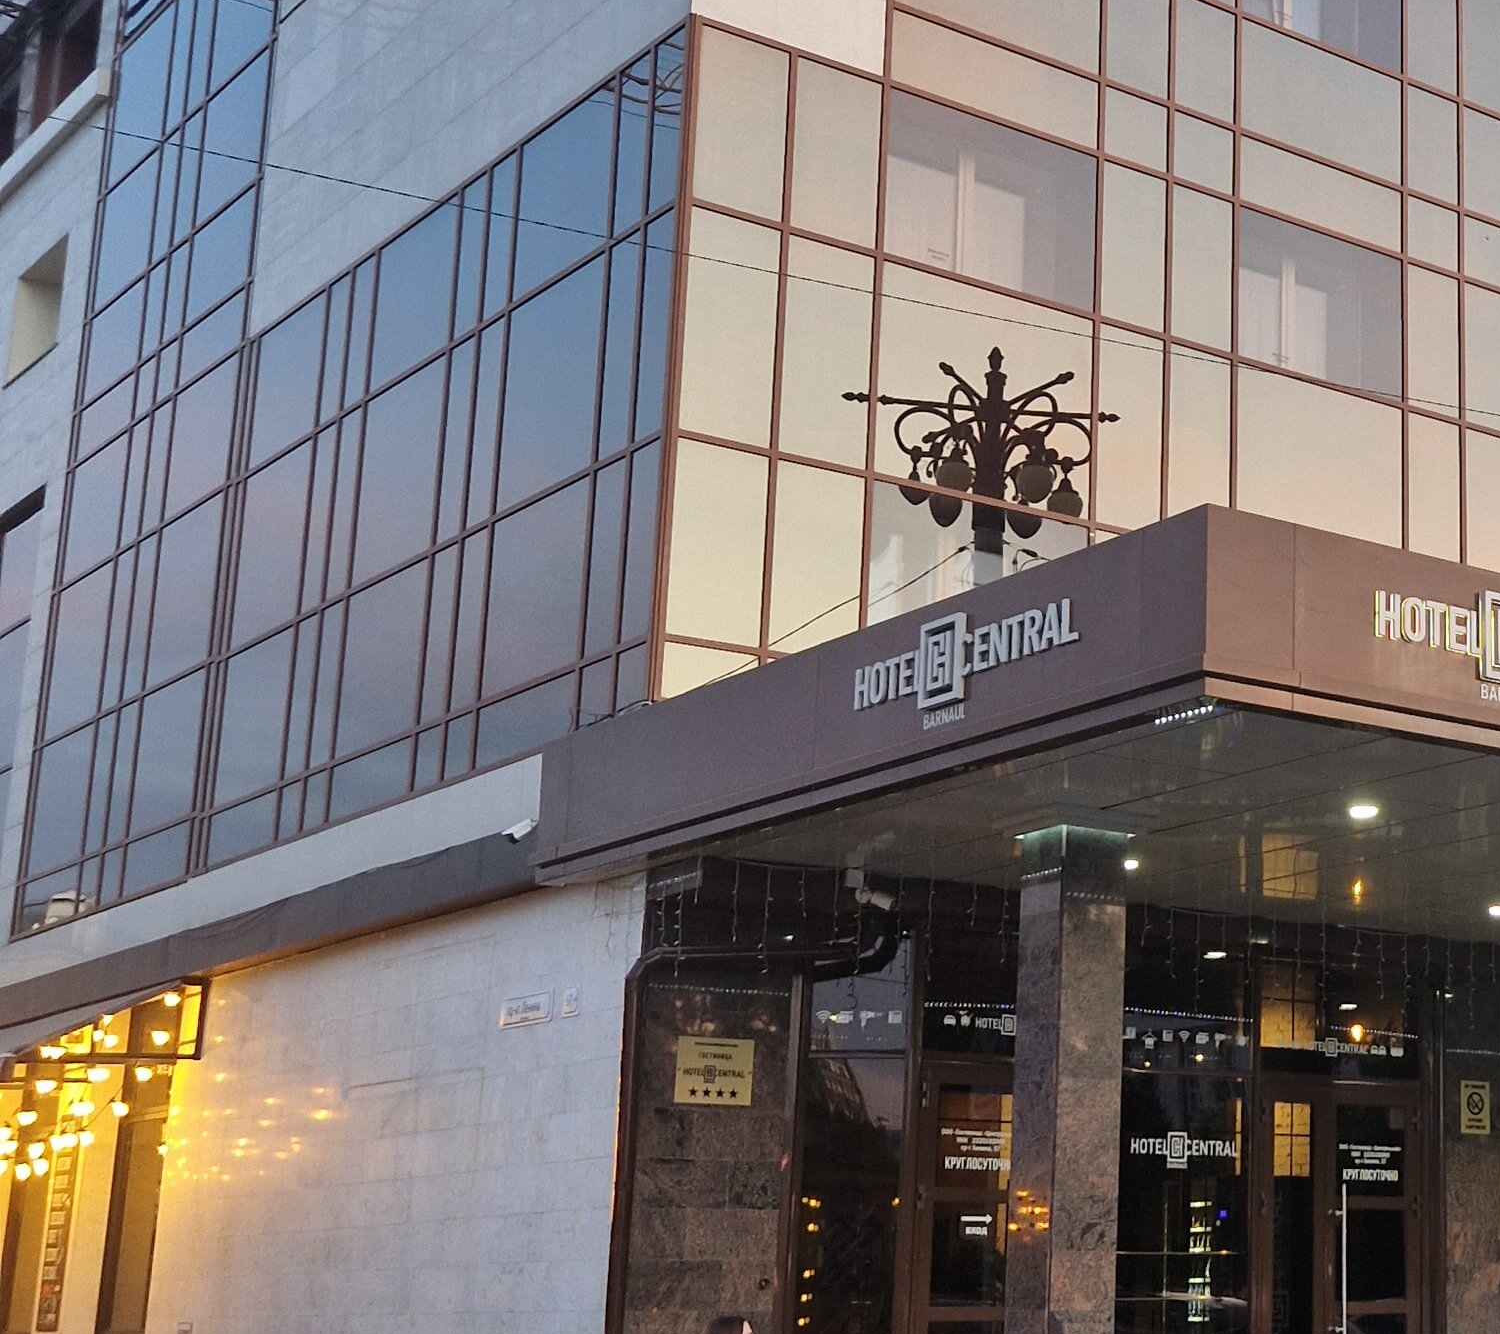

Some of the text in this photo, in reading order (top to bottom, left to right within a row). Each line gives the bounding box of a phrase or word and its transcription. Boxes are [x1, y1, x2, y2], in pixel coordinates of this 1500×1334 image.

[1374, 589, 1482, 657] HOTEL
[853, 649, 920, 711] HOTEL
[961, 597, 1080, 677] CENTRAL
[922, 702, 966, 730] BARNAUL
[1130, 1137, 1168, 1155] HOTEL
[1186, 1139, 1238, 1157] CENTRAL
[944, 1156, 1011, 1171] КРУГЛОСУТОЧН
